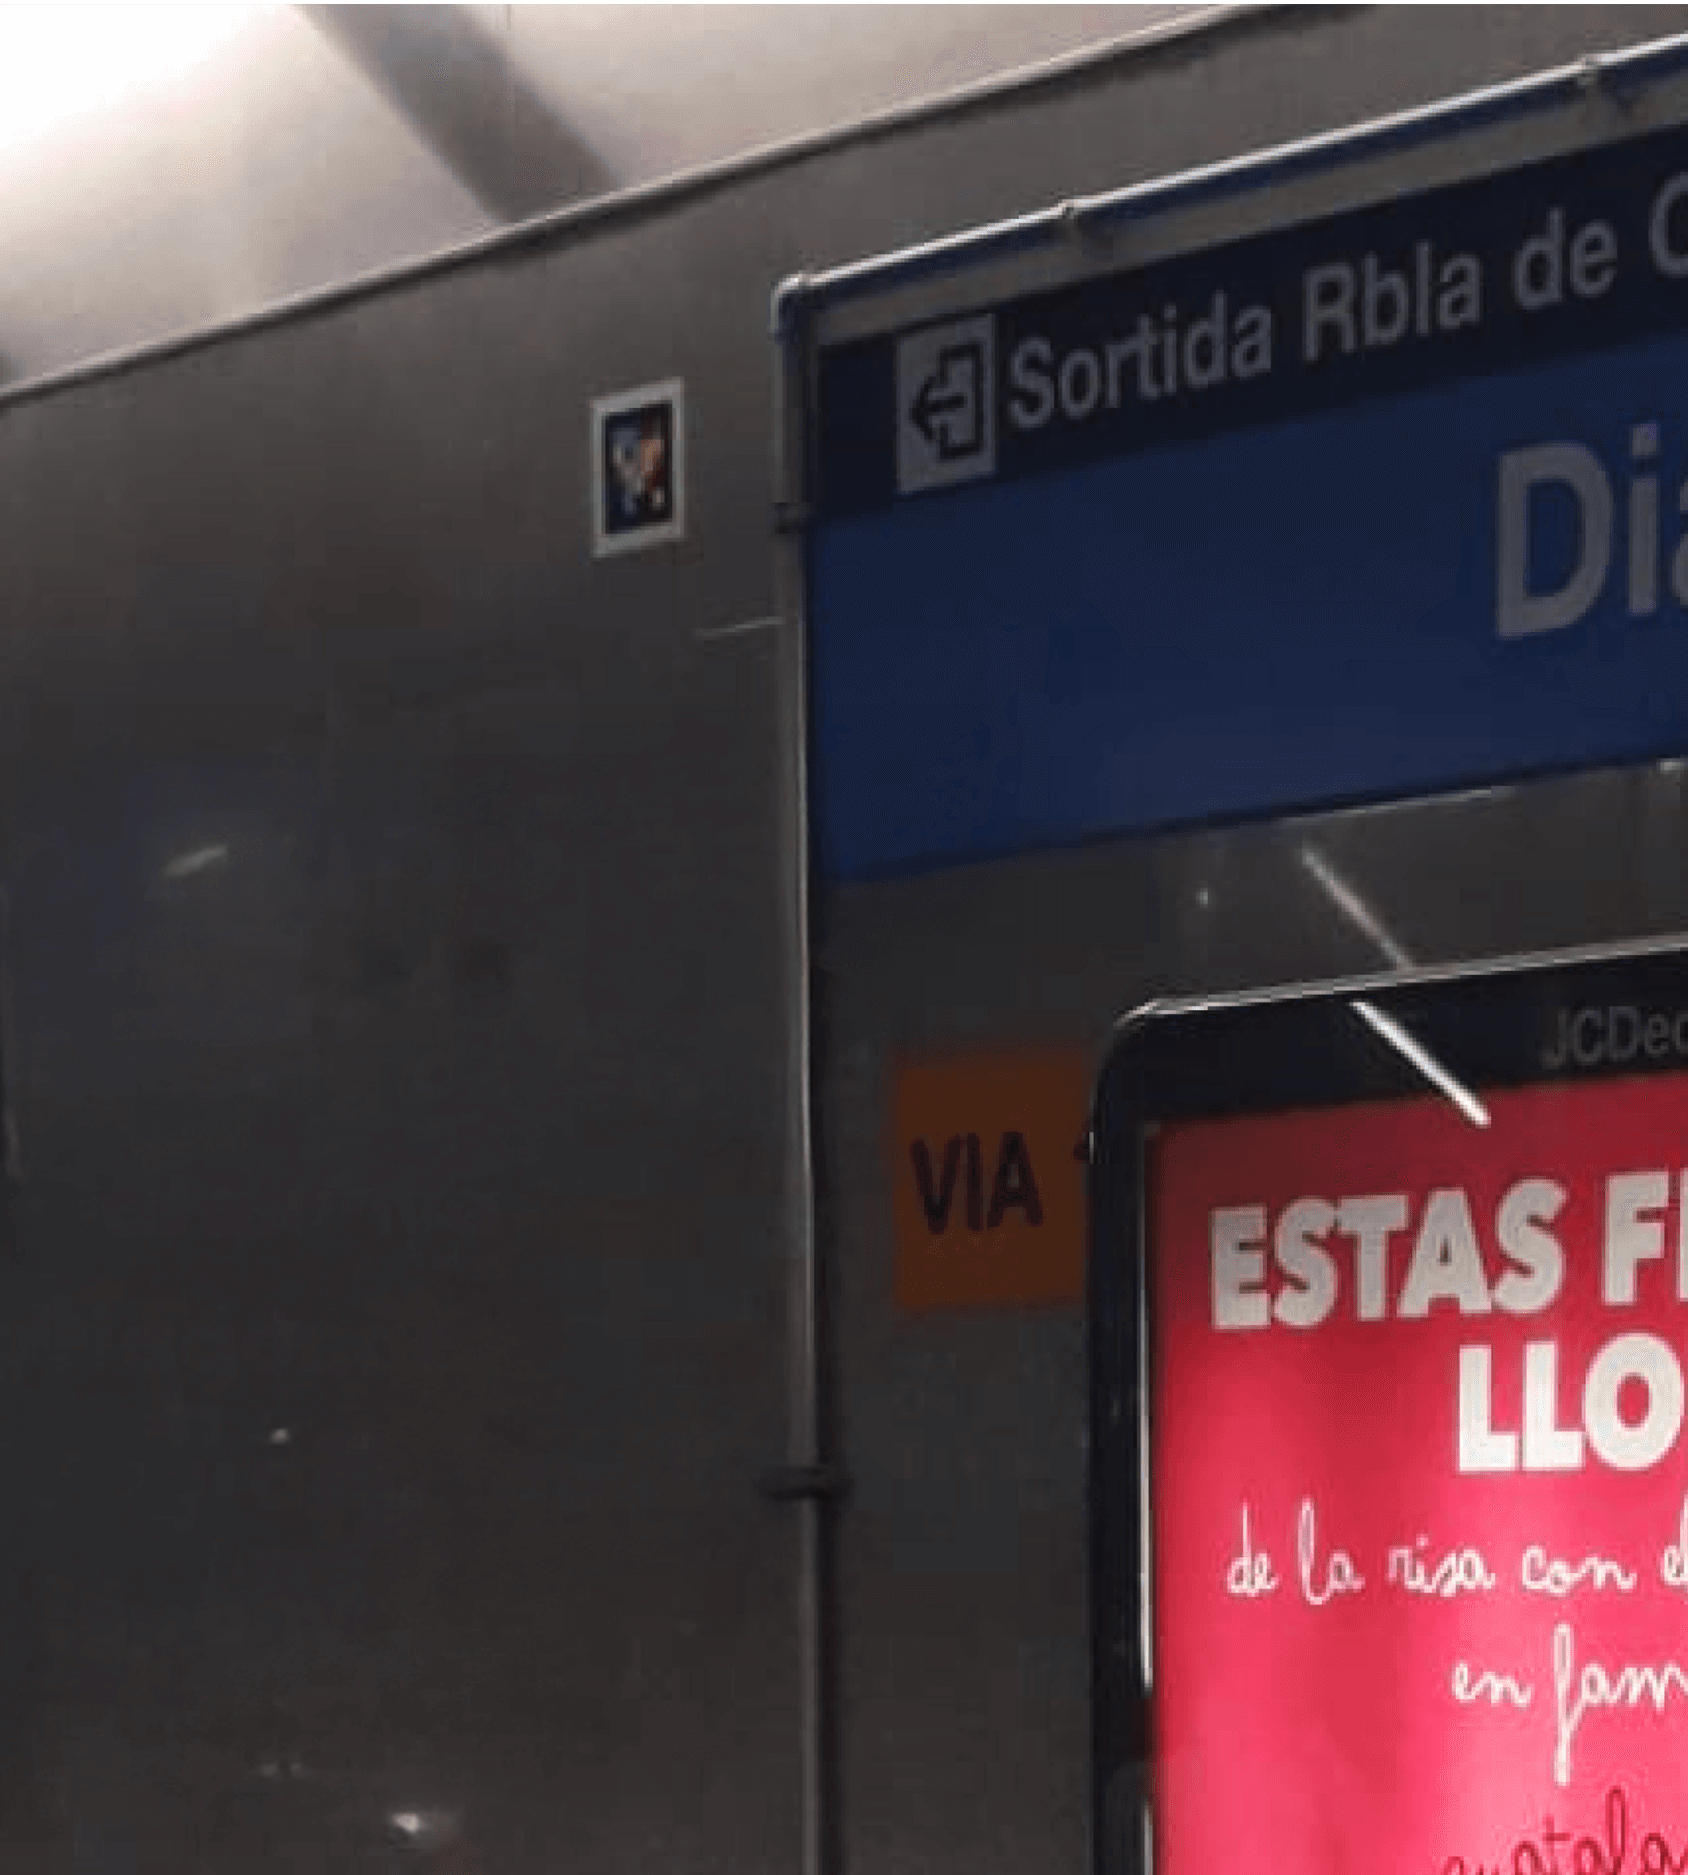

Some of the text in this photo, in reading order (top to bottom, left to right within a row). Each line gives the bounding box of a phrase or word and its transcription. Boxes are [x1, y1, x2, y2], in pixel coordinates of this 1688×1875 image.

[1007, 291, 1273, 430] Sortida
[1302, 241, 1484, 362] Rbla
[1512, 208, 1618, 311] de
[909, 1131, 1044, 1234] VIA
[1208, 1179, 1568, 1332] ESTAS
[1226, 1499, 1279, 1596] de
[1296, 1497, 1365, 1605] la
[1389, 1530, 1495, 1600] risa
[1519, 1553, 1637, 1598] con
[1451, 1660, 1532, 1709] en
